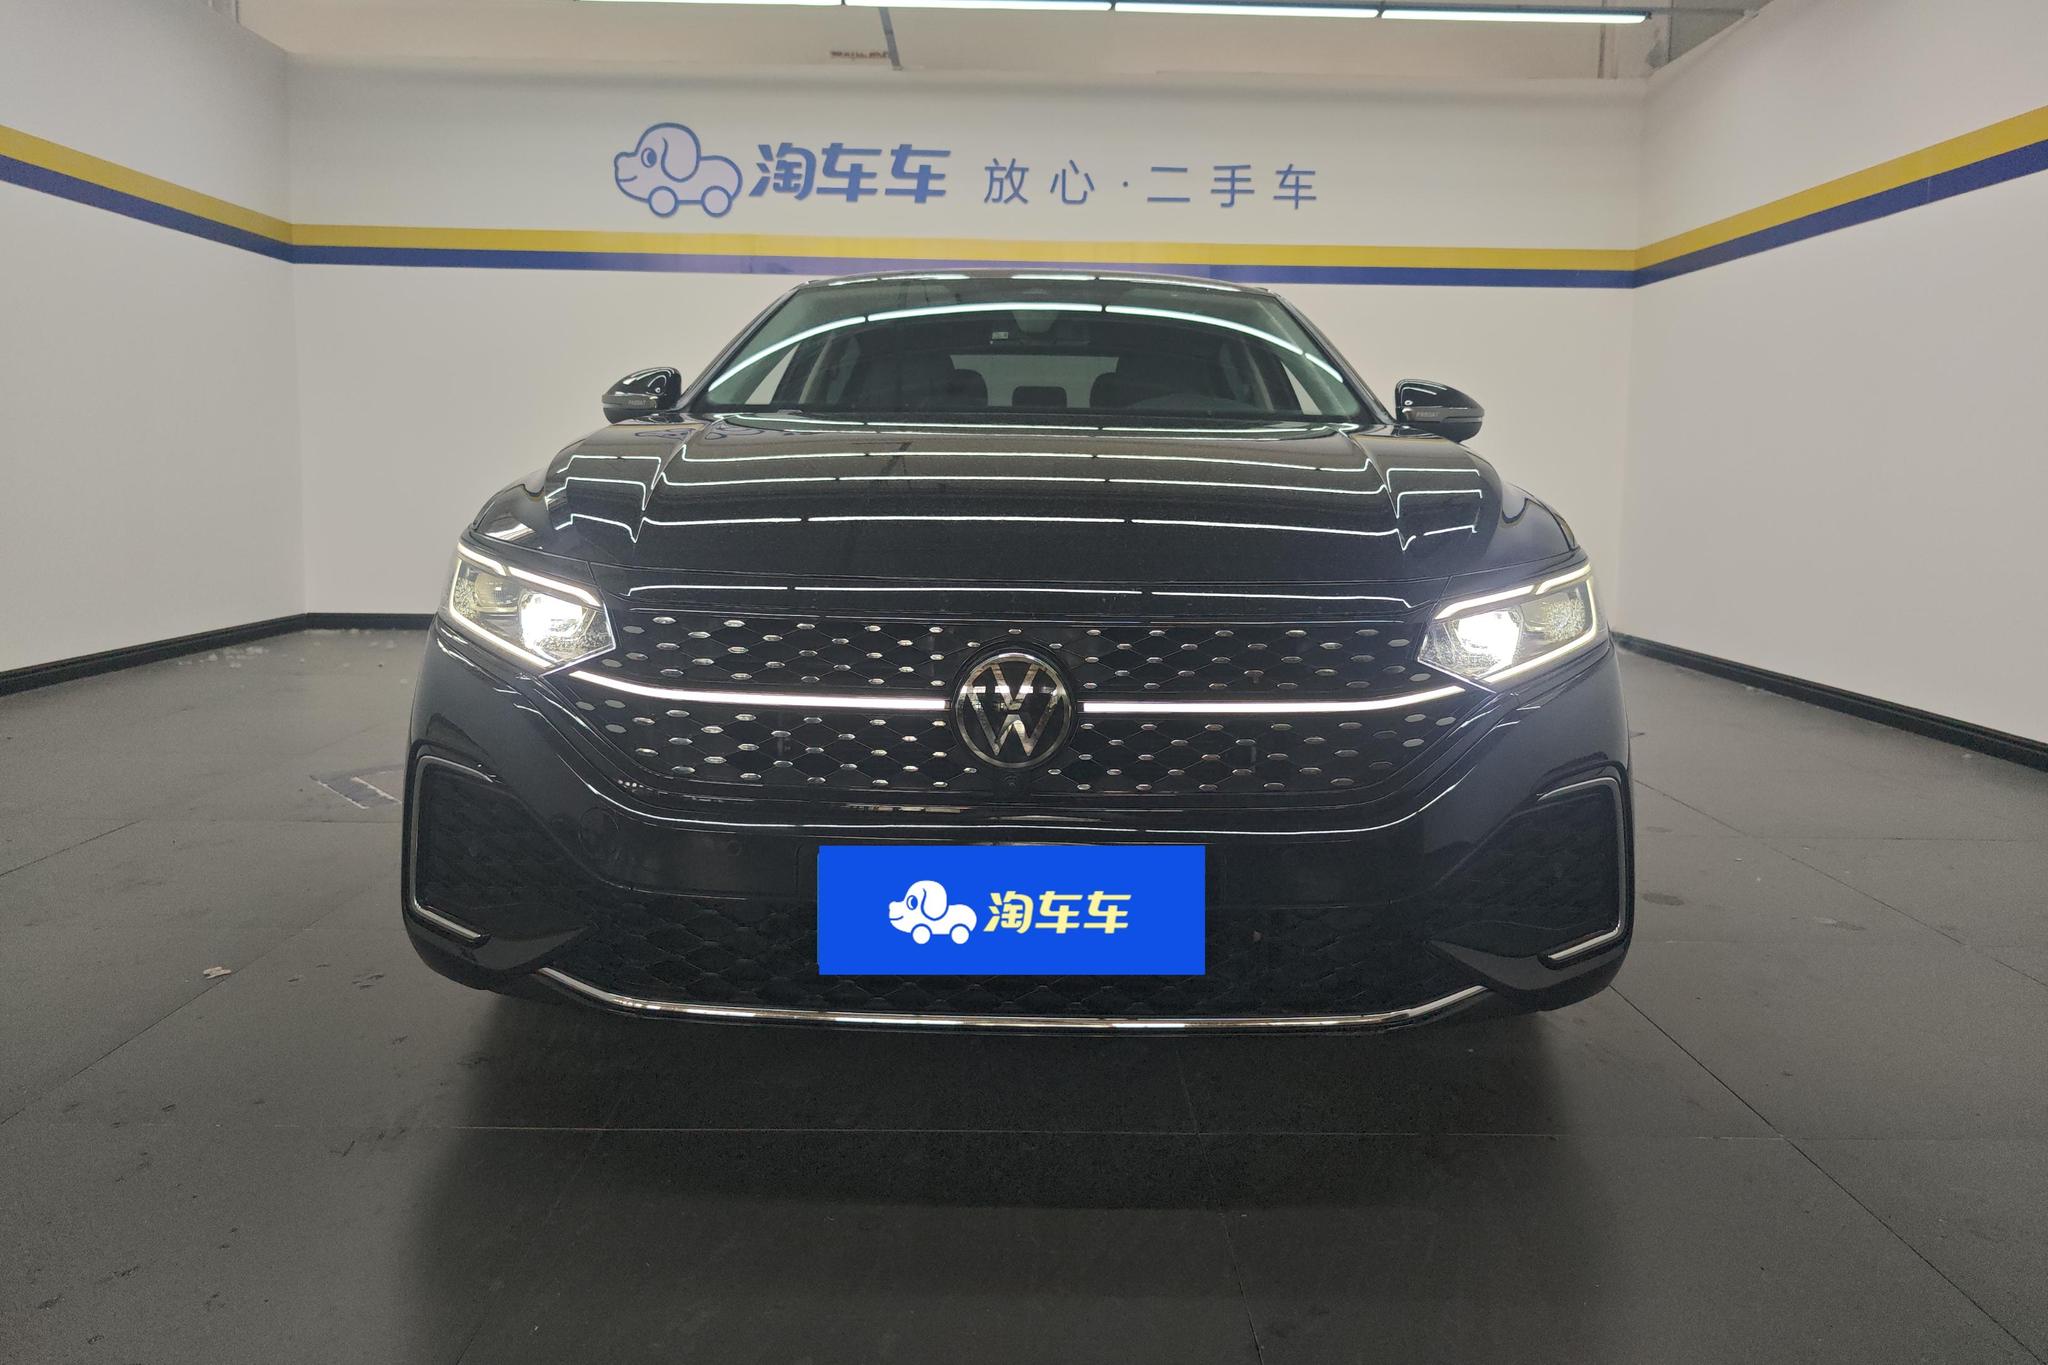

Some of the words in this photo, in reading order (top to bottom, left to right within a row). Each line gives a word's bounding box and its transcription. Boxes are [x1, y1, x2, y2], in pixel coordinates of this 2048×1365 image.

[748, 141, 951, 205] 淘车车
[962, 660, 1064, 758] VW
